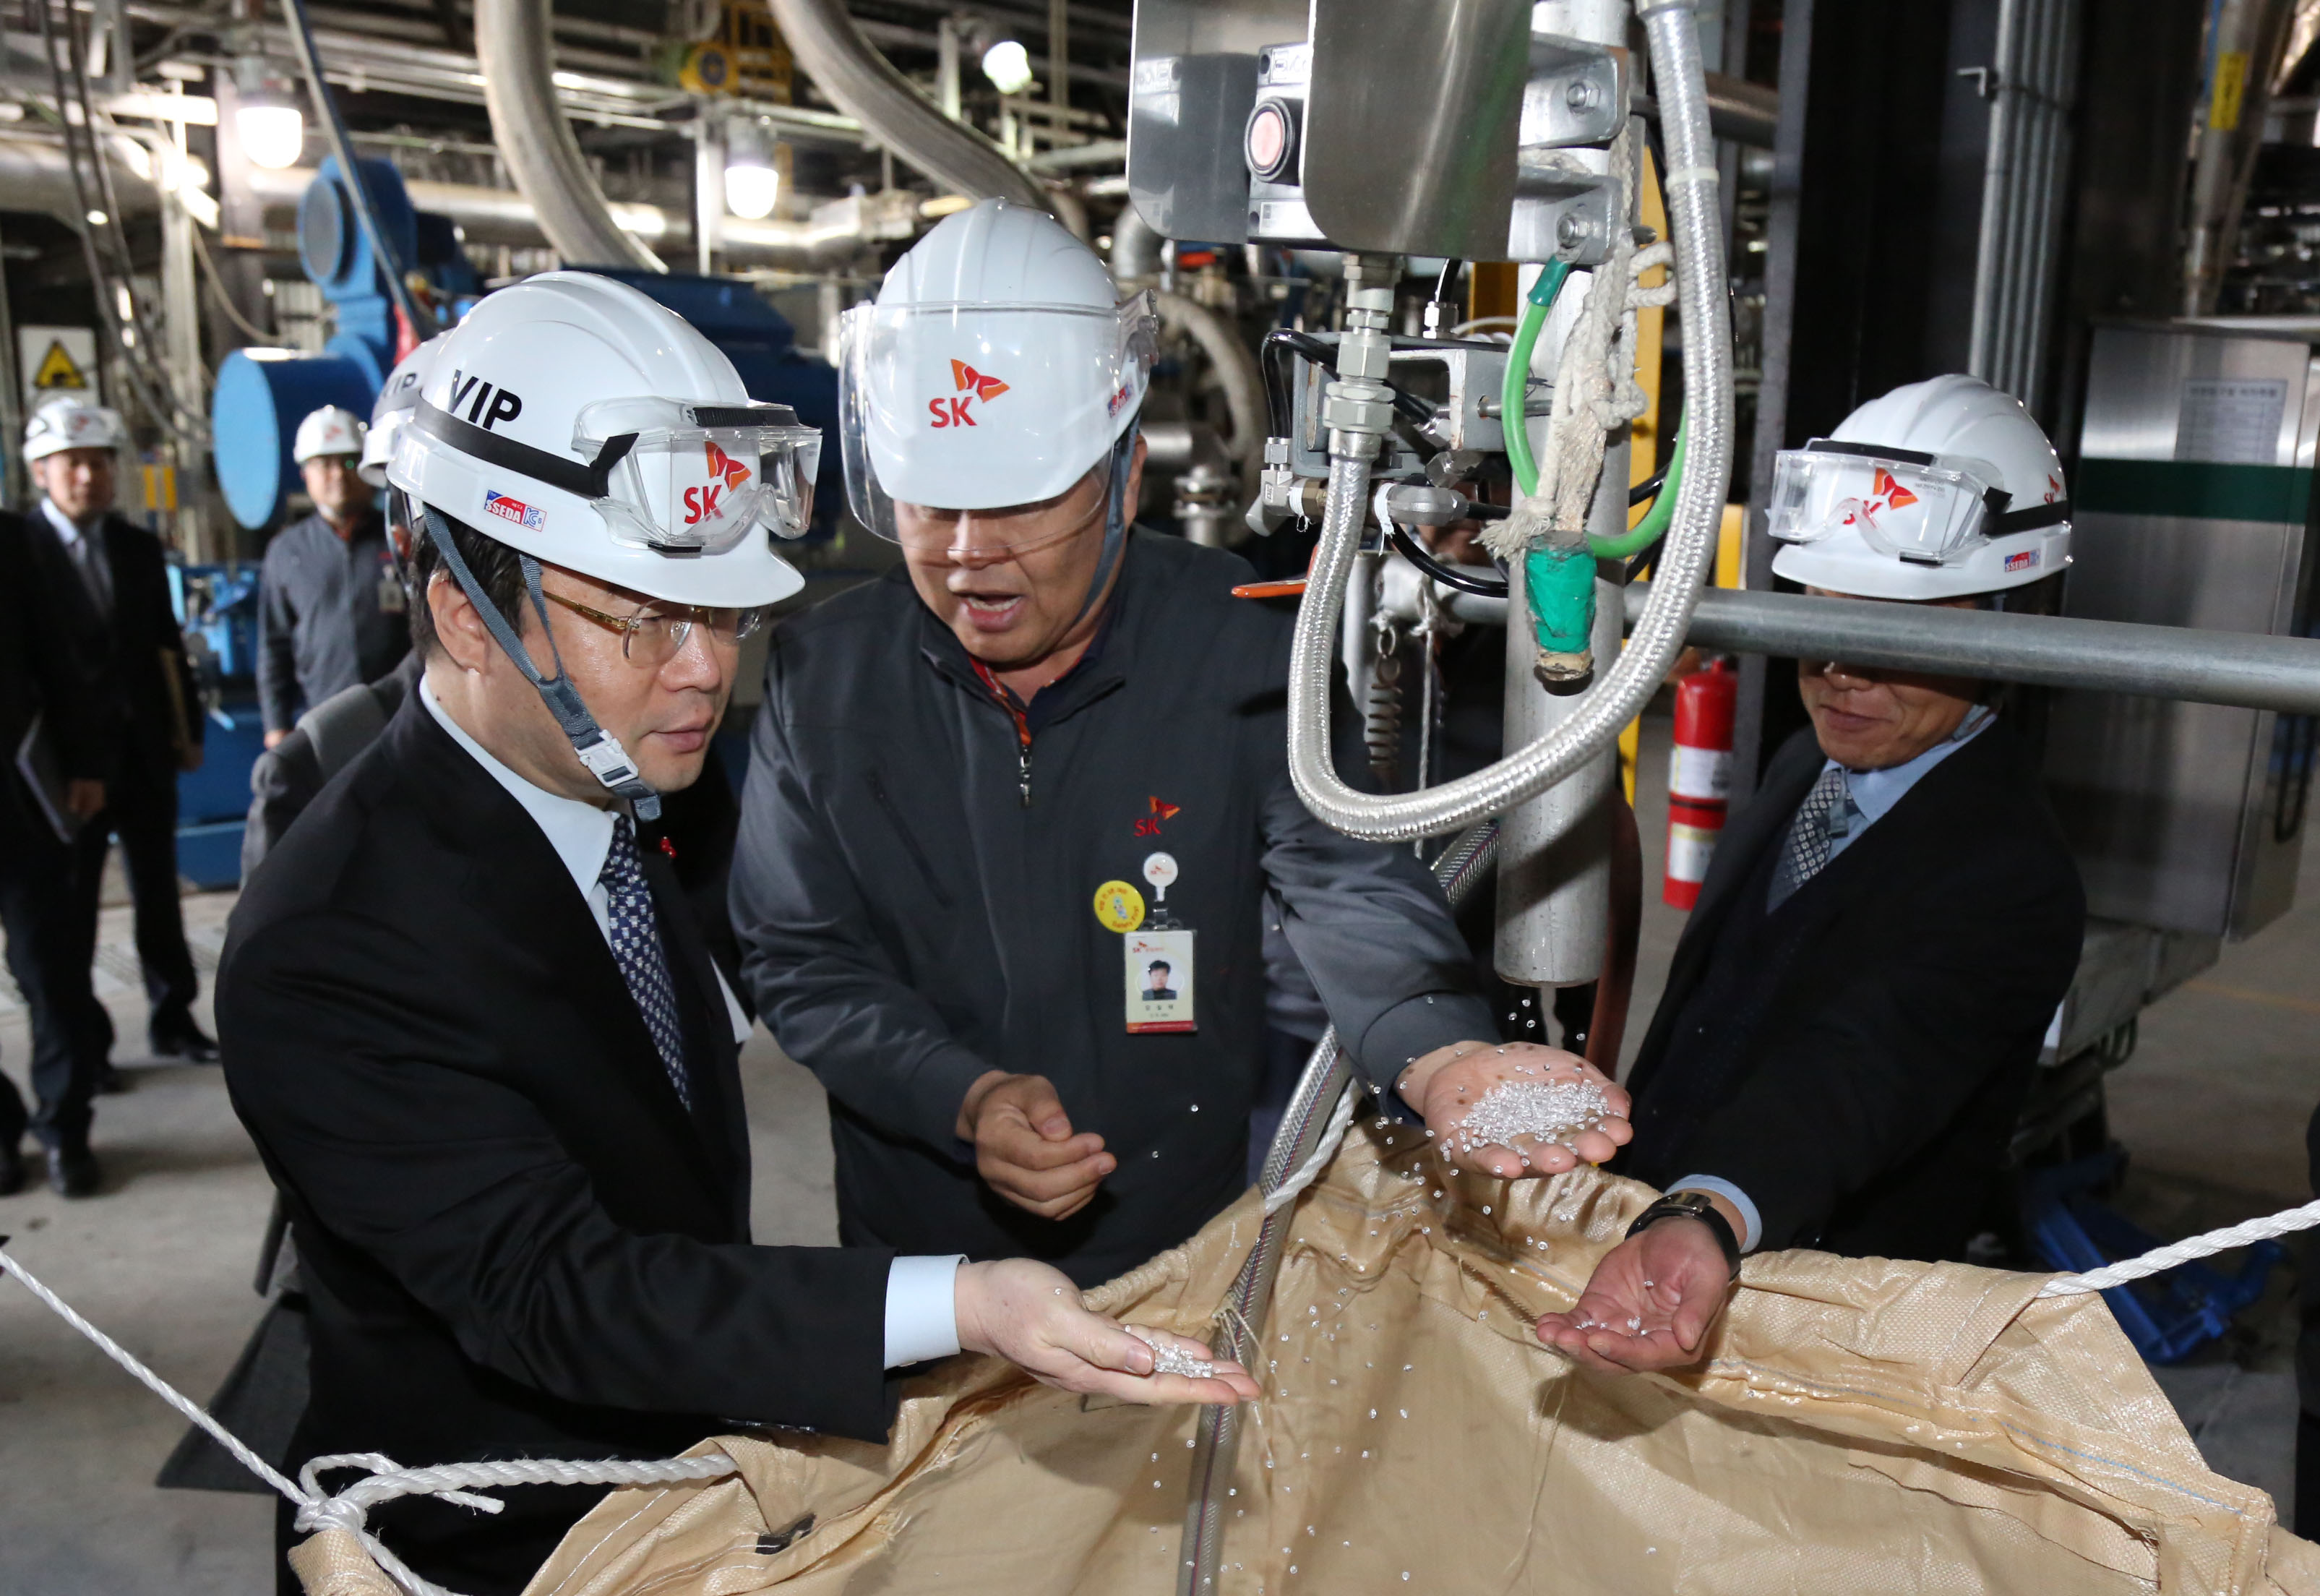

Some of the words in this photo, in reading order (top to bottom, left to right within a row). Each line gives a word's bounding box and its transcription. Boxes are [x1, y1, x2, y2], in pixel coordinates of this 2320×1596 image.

[447, 369, 522, 430] VIP
[929, 396, 977, 428] SK
[486, 499, 521, 523] SSEDA
[684, 484, 723, 524] SK
[1133, 818, 1161, 836] SK
